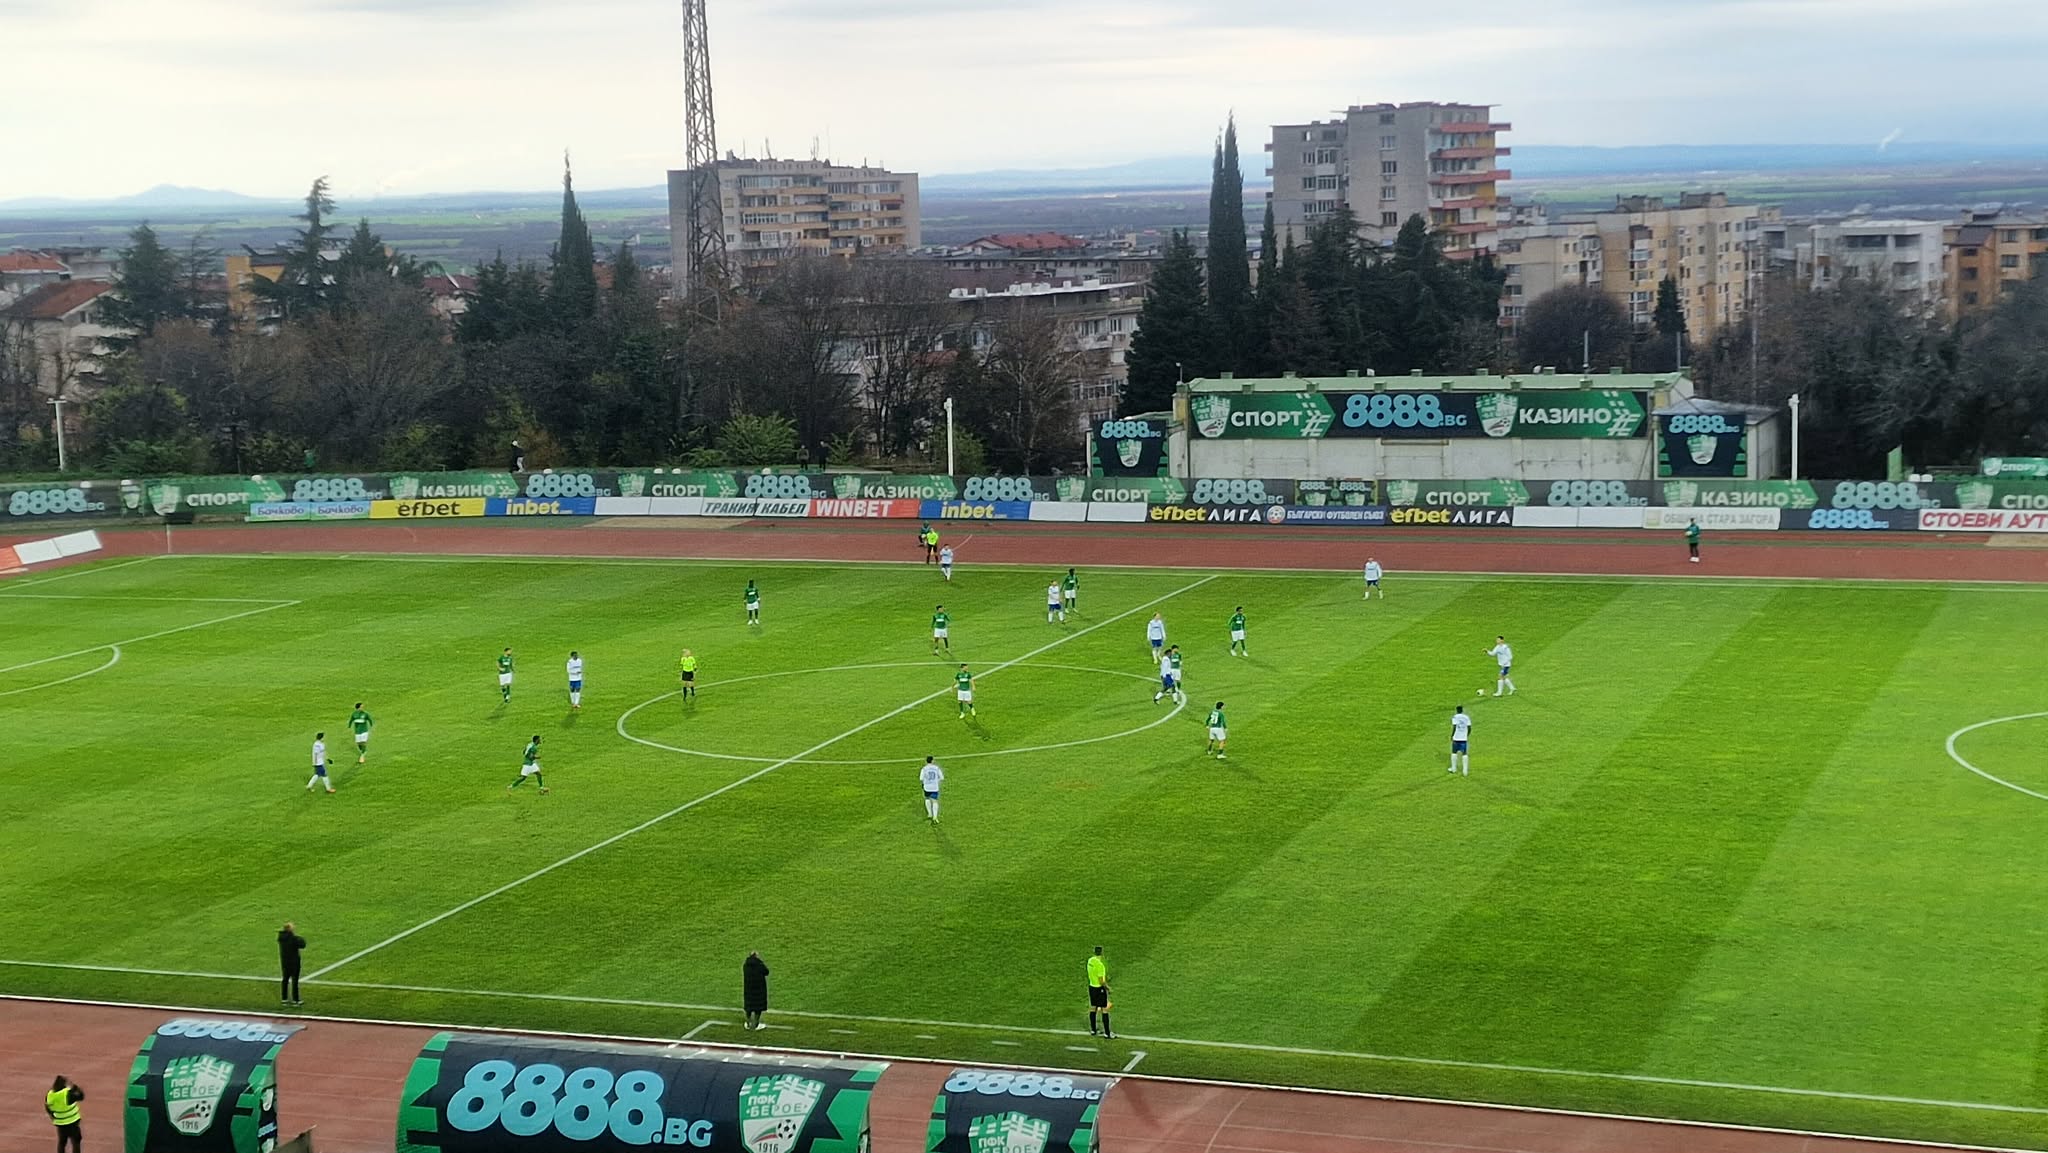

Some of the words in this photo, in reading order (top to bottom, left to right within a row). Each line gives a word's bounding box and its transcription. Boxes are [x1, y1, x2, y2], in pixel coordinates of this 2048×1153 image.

[1342, 393, 1467, 428] 8888.BG
[1519, 407, 1612, 425] КАЗИНО
[1231, 410, 1303, 427] СПОРТ
[422, 484, 496, 498] КАЗИНО
[526, 473, 611, 498] 8888.BG
[652, 484, 706, 497] СПОРТ
[745, 474, 827, 499] 8888.BG
[863, 486, 935, 499] КАЗИНО
[963, 476, 1050, 501] 8888.BG
[1192, 479, 1284, 504] 8888.BG
[186, 492, 250, 507] СПОРТ
[1091, 488, 1151, 503] СПОРТ
[1425, 491, 1491, 506] СПОРТ
[1548, 480, 1648, 507] 8888.BG
[1701, 491, 1790, 507] КАЗИНО
[1831, 481, 1941, 509] 8888.BG
[257, 506, 305, 516] Бачково
[317, 505, 364, 514] Бачково
[397, 502, 461, 517] efbet
[760, 503, 807, 514] КАБЕЛ
[815, 500, 893, 518] WINBET
[1150, 506, 1206, 521] efbet
[1207, 508, 1261, 522] ЛИГА
[1391, 509, 1450, 524] efbet
[1452, 510, 1510, 524] ЛИГА
[1922, 512, 2003, 528] СТОЕВИ
[945, 1072, 1100, 1100] 8888.BG
[446, 1060, 713, 1147] 8888.BG
[748, 1094, 776, 1106] ПФК
[750, 1103, 803, 1117] БЕРОЕ
[181, 1121, 199, 1130] 1916
[978, 1136, 1006, 1148] ПФК
